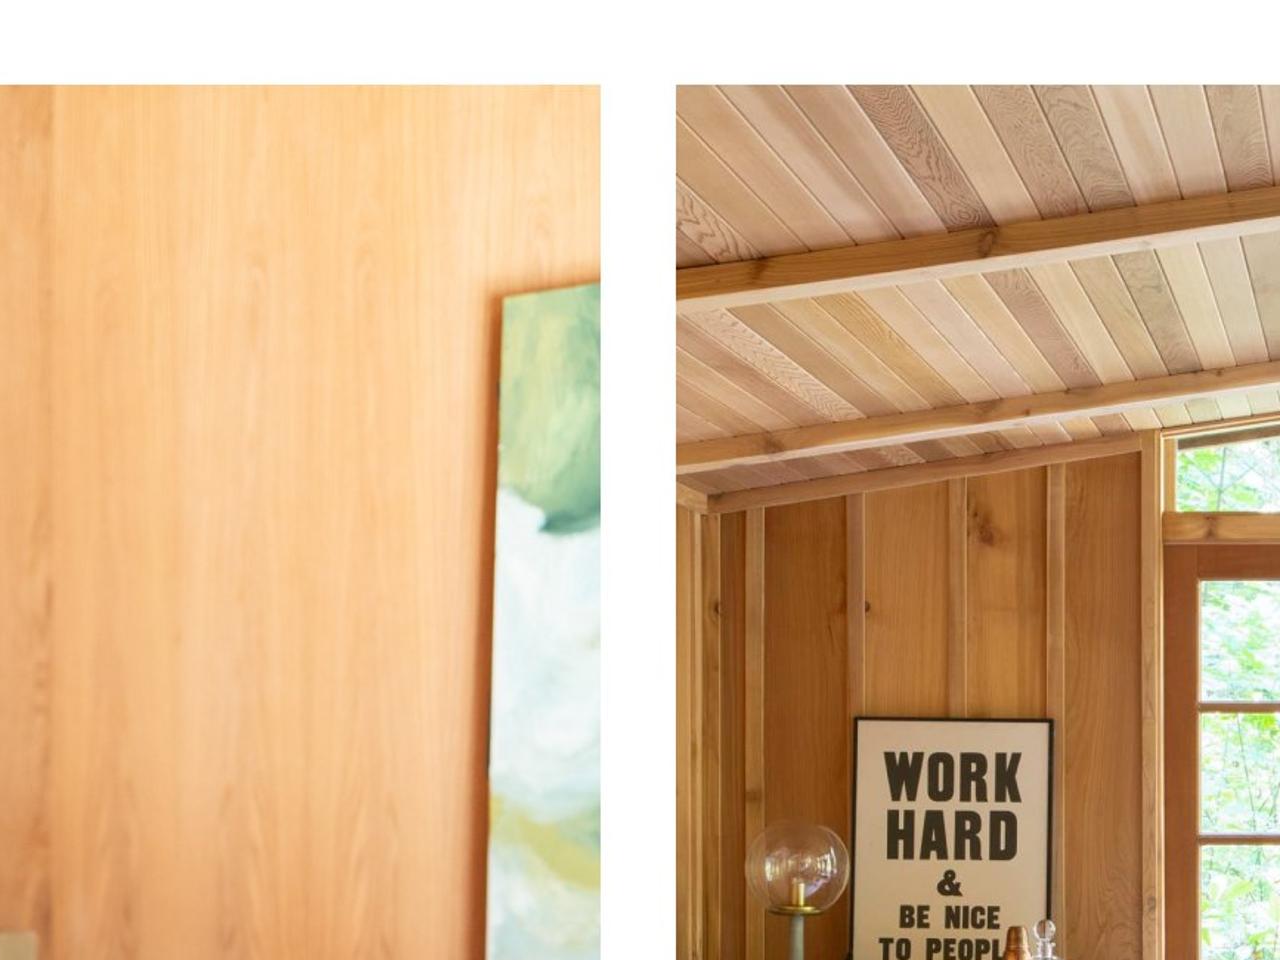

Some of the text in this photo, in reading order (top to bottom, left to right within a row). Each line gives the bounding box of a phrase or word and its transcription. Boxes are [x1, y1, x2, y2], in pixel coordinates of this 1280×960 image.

[884, 752, 1021, 802] WORK
[887, 810, 1017, 860] HARD
[937, 870, 962, 896] &
[900, 905, 1000, 929] BE NICE
[879, 938, 911, 960] TO
